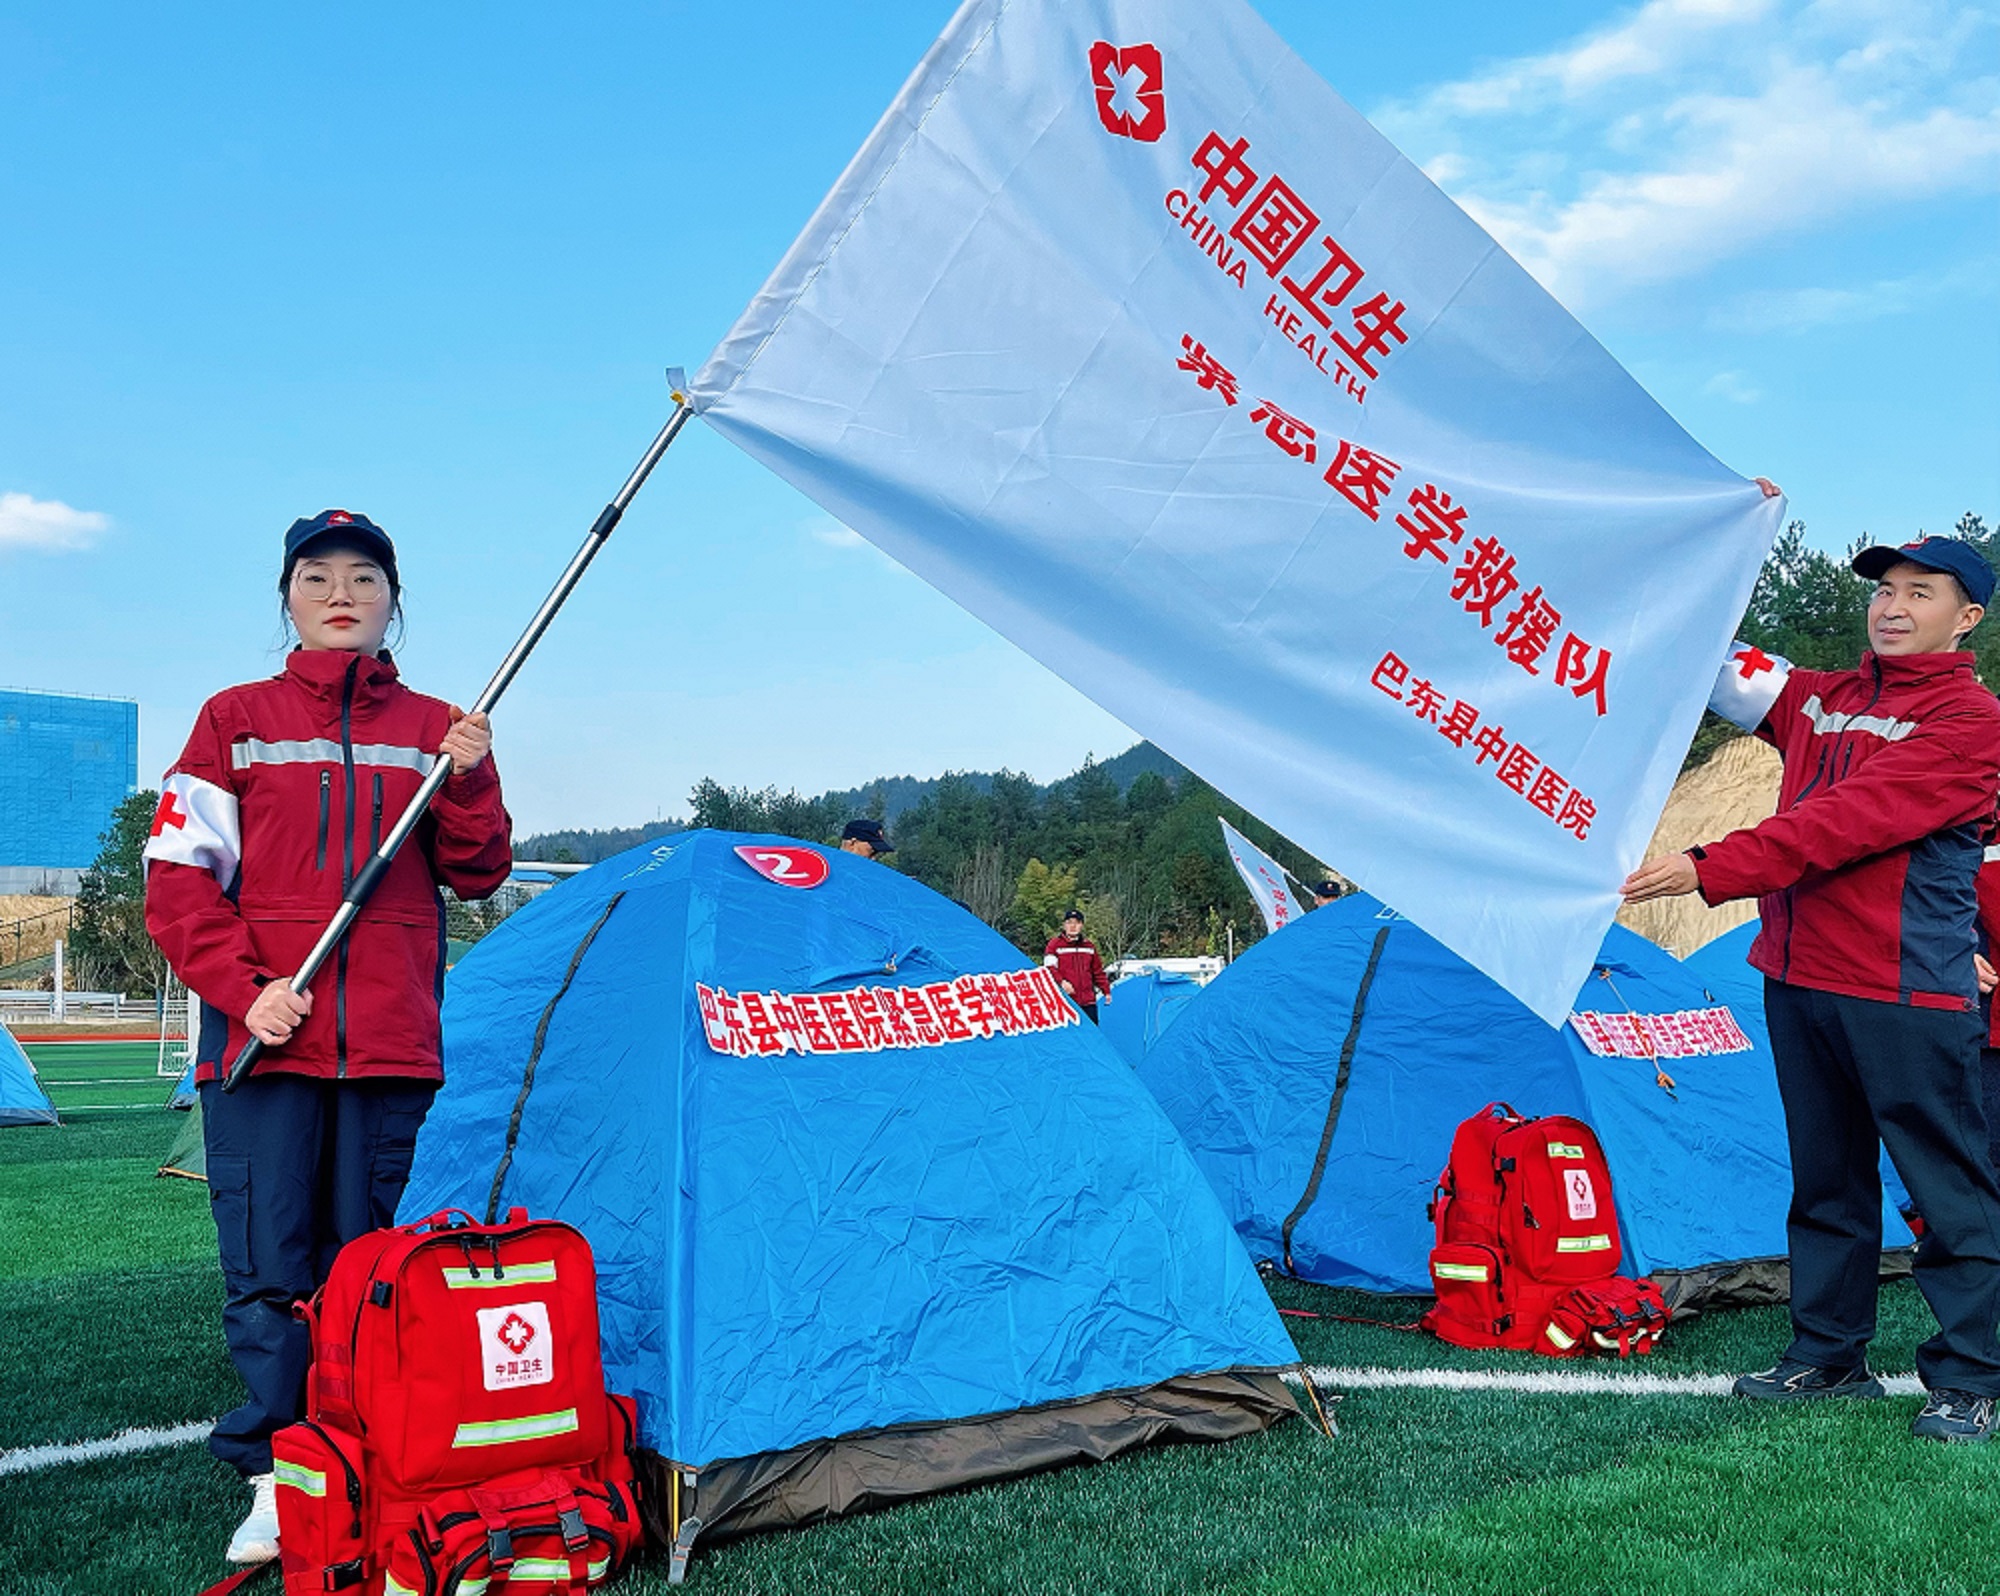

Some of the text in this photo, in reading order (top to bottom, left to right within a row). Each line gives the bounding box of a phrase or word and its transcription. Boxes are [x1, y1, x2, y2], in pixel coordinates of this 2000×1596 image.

[1164, 189, 1367, 404] CHINA HEALTH
[1190, 130, 1410, 380] 中国卫生
[1370, 651, 1598, 841] 巴东县中医医院
[755, 853, 810, 879] 2
[698, 969, 1077, 1056] 巴东县中医医院紧急医学救援队
[495, 1358, 543, 1376] 中国卫生
